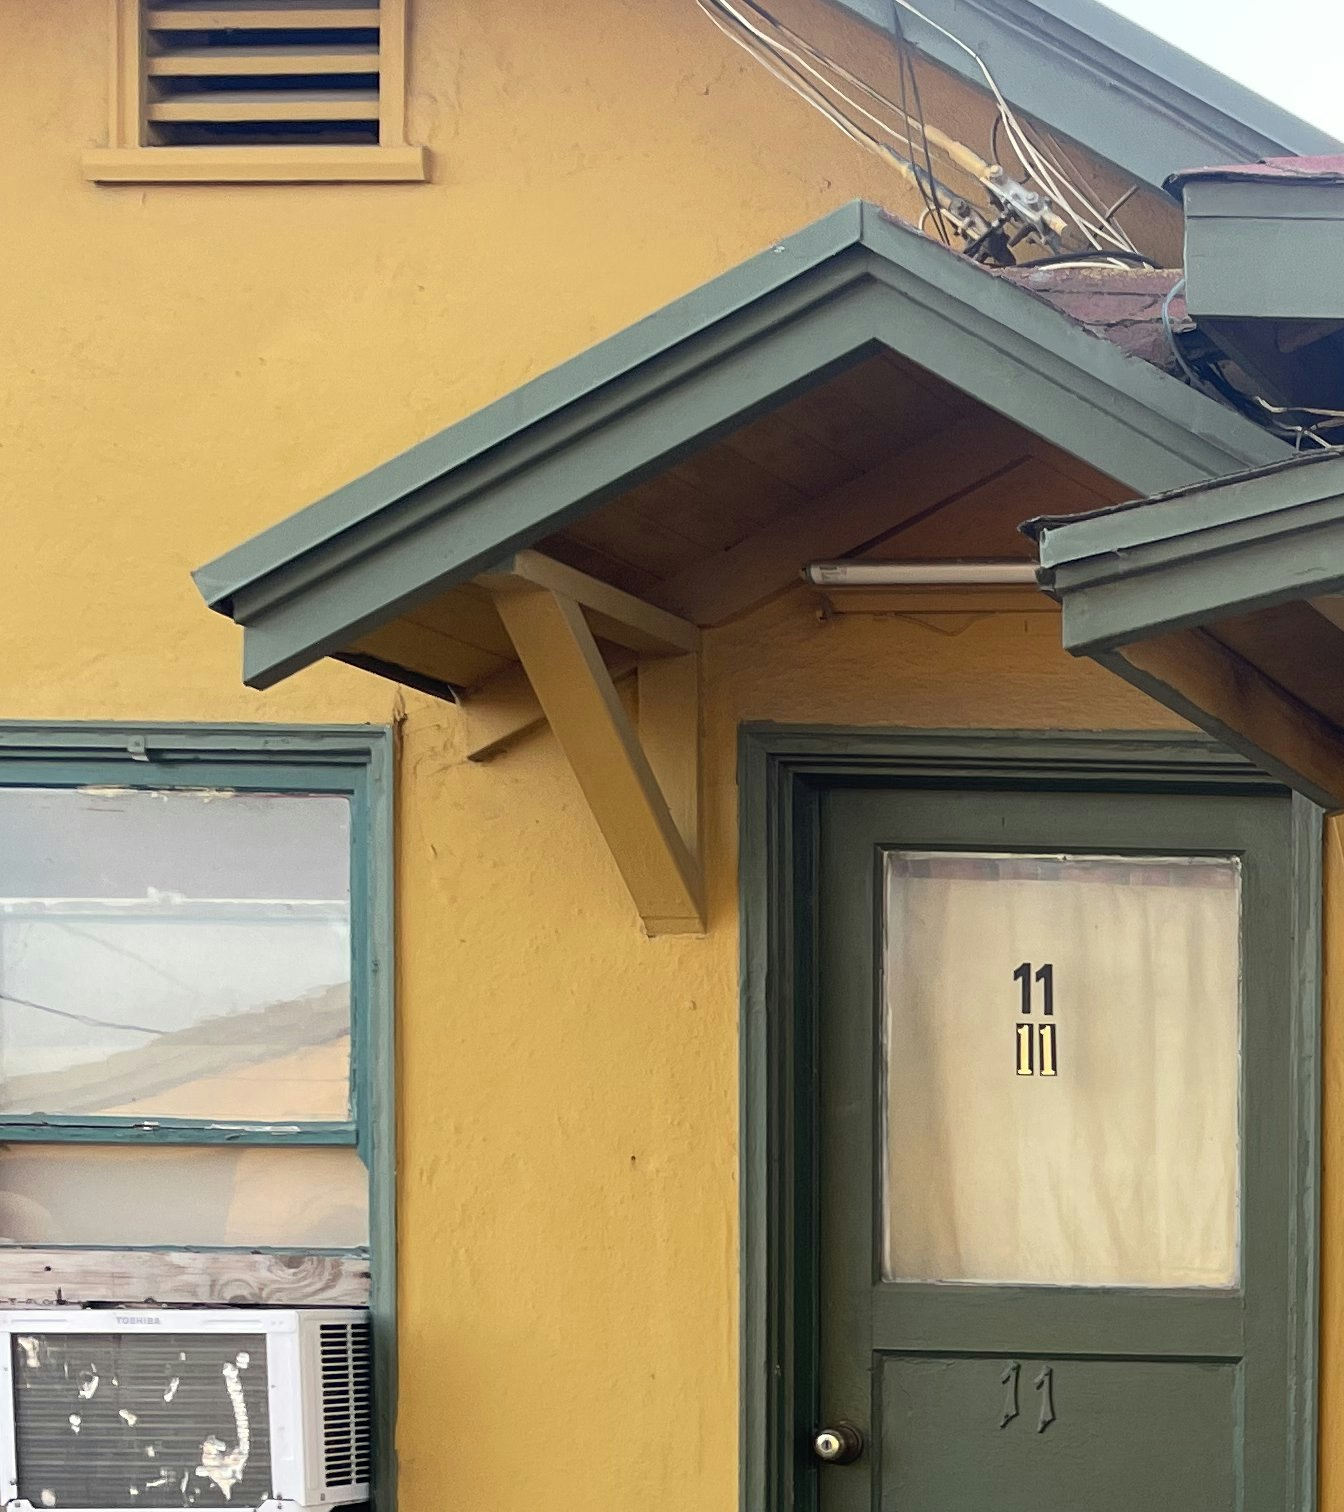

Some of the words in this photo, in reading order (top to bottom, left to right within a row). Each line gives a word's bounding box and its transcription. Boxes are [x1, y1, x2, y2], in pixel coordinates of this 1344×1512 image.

[1013, 962, 1054, 1016] 11
[1016, 1023, 1057, 1076] 11
[116, 1316, 161, 1325] TOSHIBA
[1000, 1360, 1056, 1434] 11
